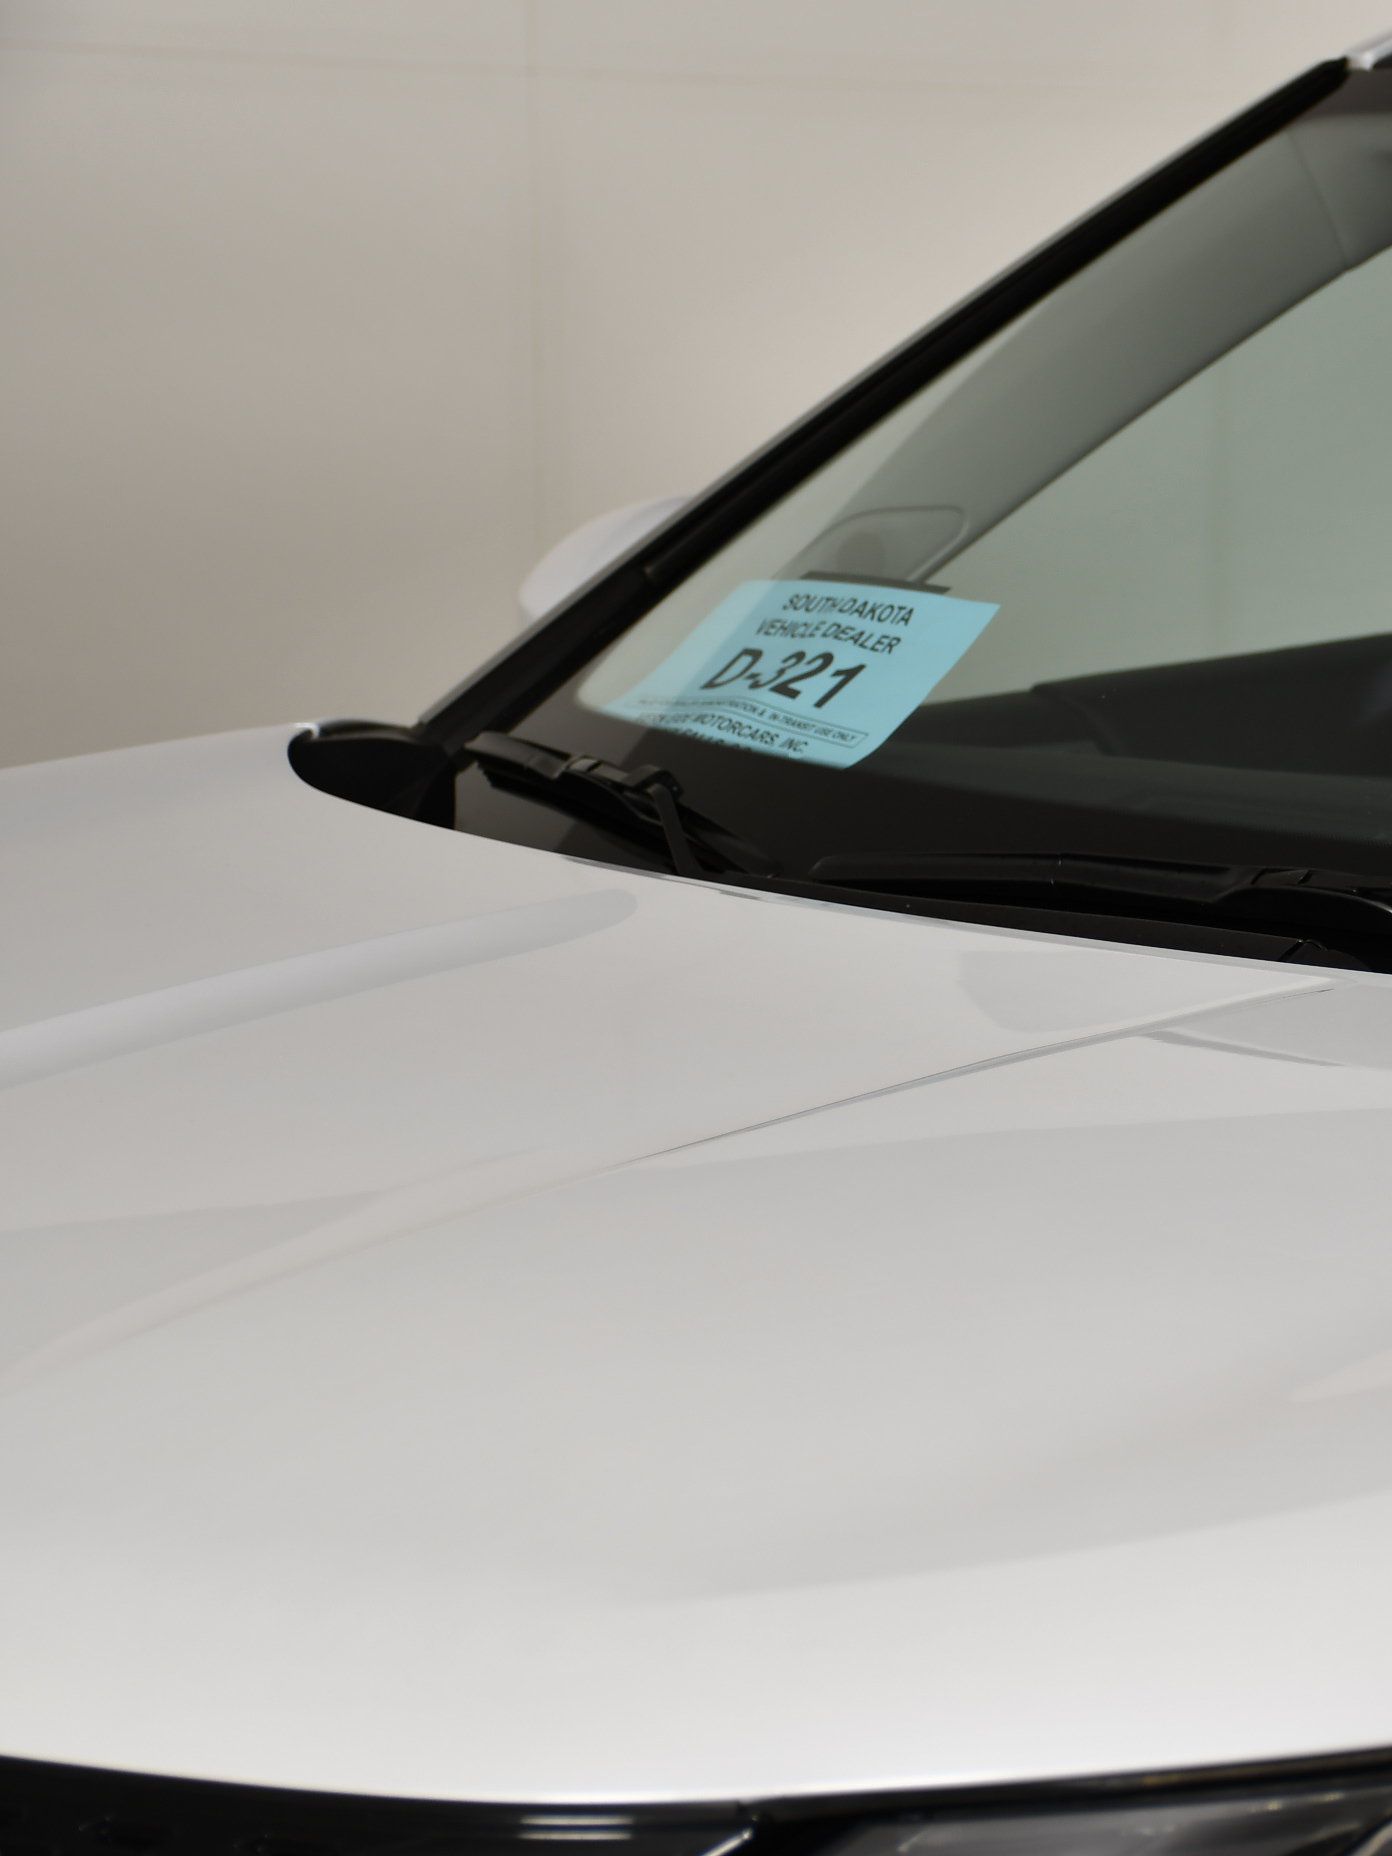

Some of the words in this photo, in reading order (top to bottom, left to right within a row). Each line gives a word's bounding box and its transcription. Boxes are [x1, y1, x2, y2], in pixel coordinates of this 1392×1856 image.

[782, 593, 842, 613] SOUTH
[838, 596, 915, 627] DAKOTA
[755, 617, 827, 638] VEHICLE
[820, 621, 902, 654] DEALER
[699, 647, 867, 709] D-321
[832, 730, 857, 742] ONLY
